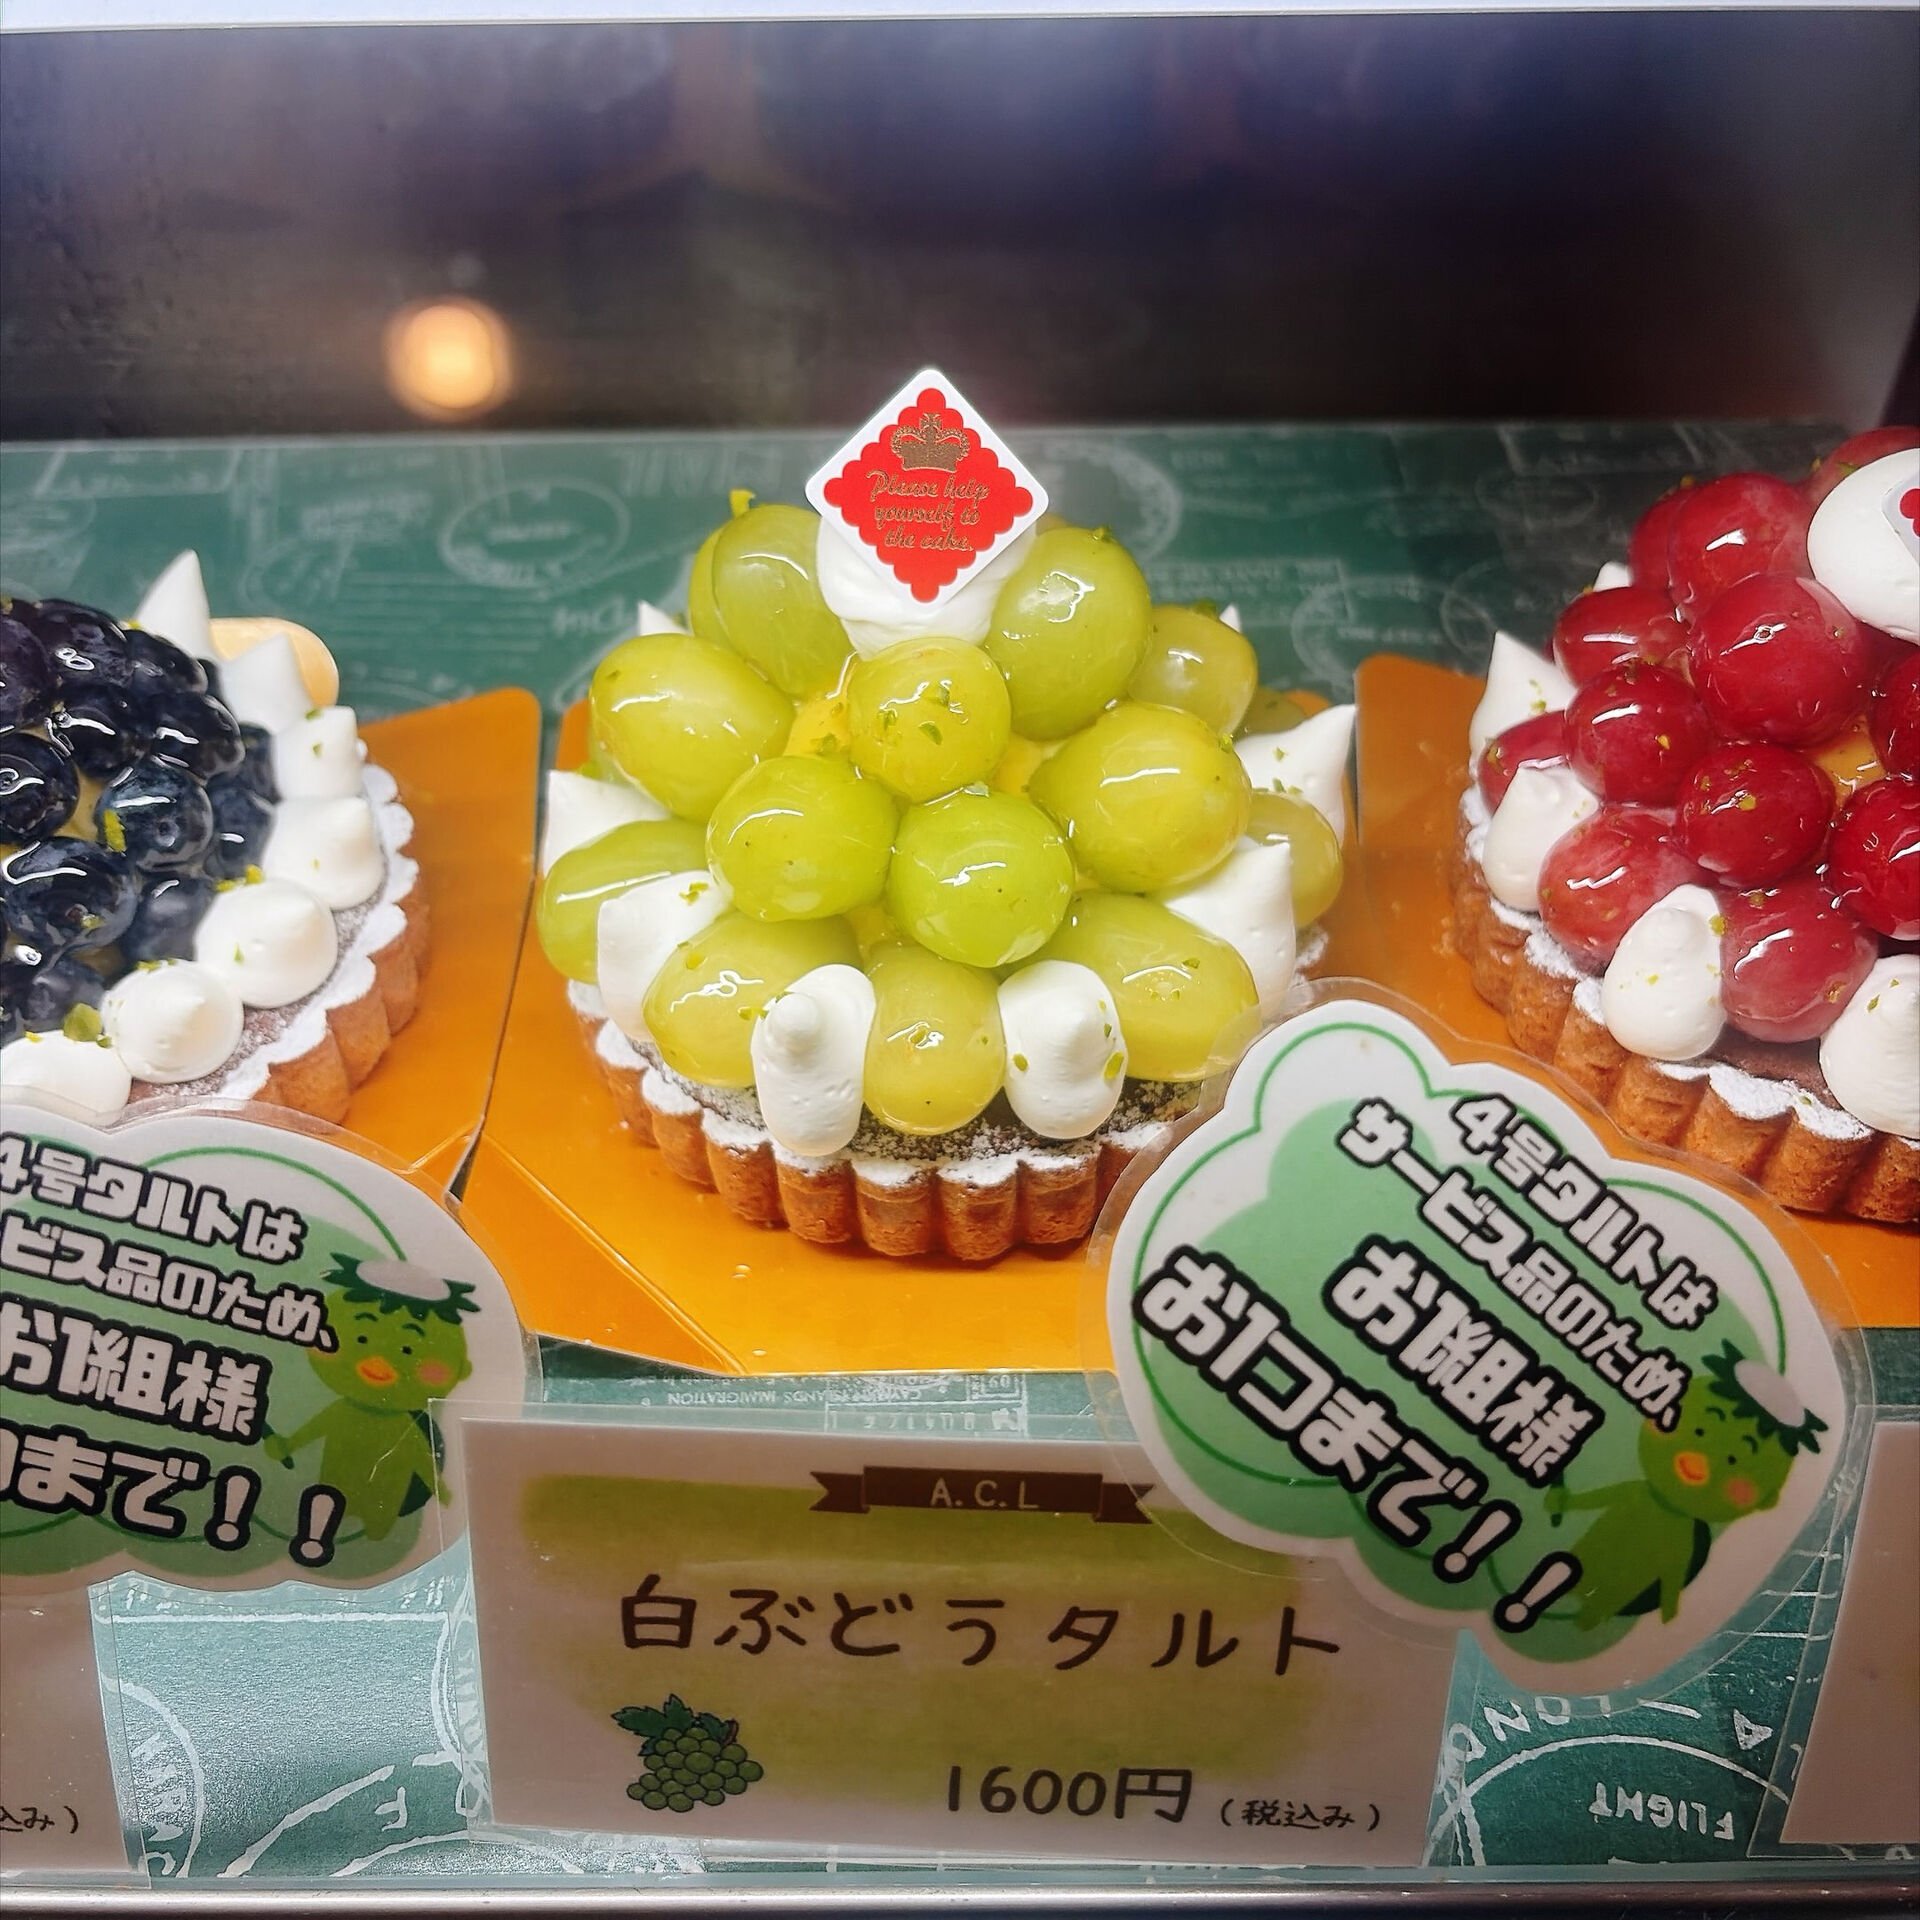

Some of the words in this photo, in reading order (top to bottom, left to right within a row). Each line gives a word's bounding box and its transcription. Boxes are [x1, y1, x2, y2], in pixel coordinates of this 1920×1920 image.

[866, 469, 939, 502] Please
[943, 475, 989, 509] help
[874, 499, 955, 532] yourself
[960, 506, 980, 526] to
[885, 523, 916, 549] the
[919, 526, 973, 552] cake.
[1452, 1094, 1718, 1329] 4号タルトは
[1334, 1098, 1693, 1432] サービス品のため、
[1323, 1233, 1605, 1489] お1組様
[620, 1574, 1341, 1677] 白ぶどうタルト
[946, 1765, 1193, 1823] 1600円
[1588, 1782, 1735, 1841] FLIGHT
